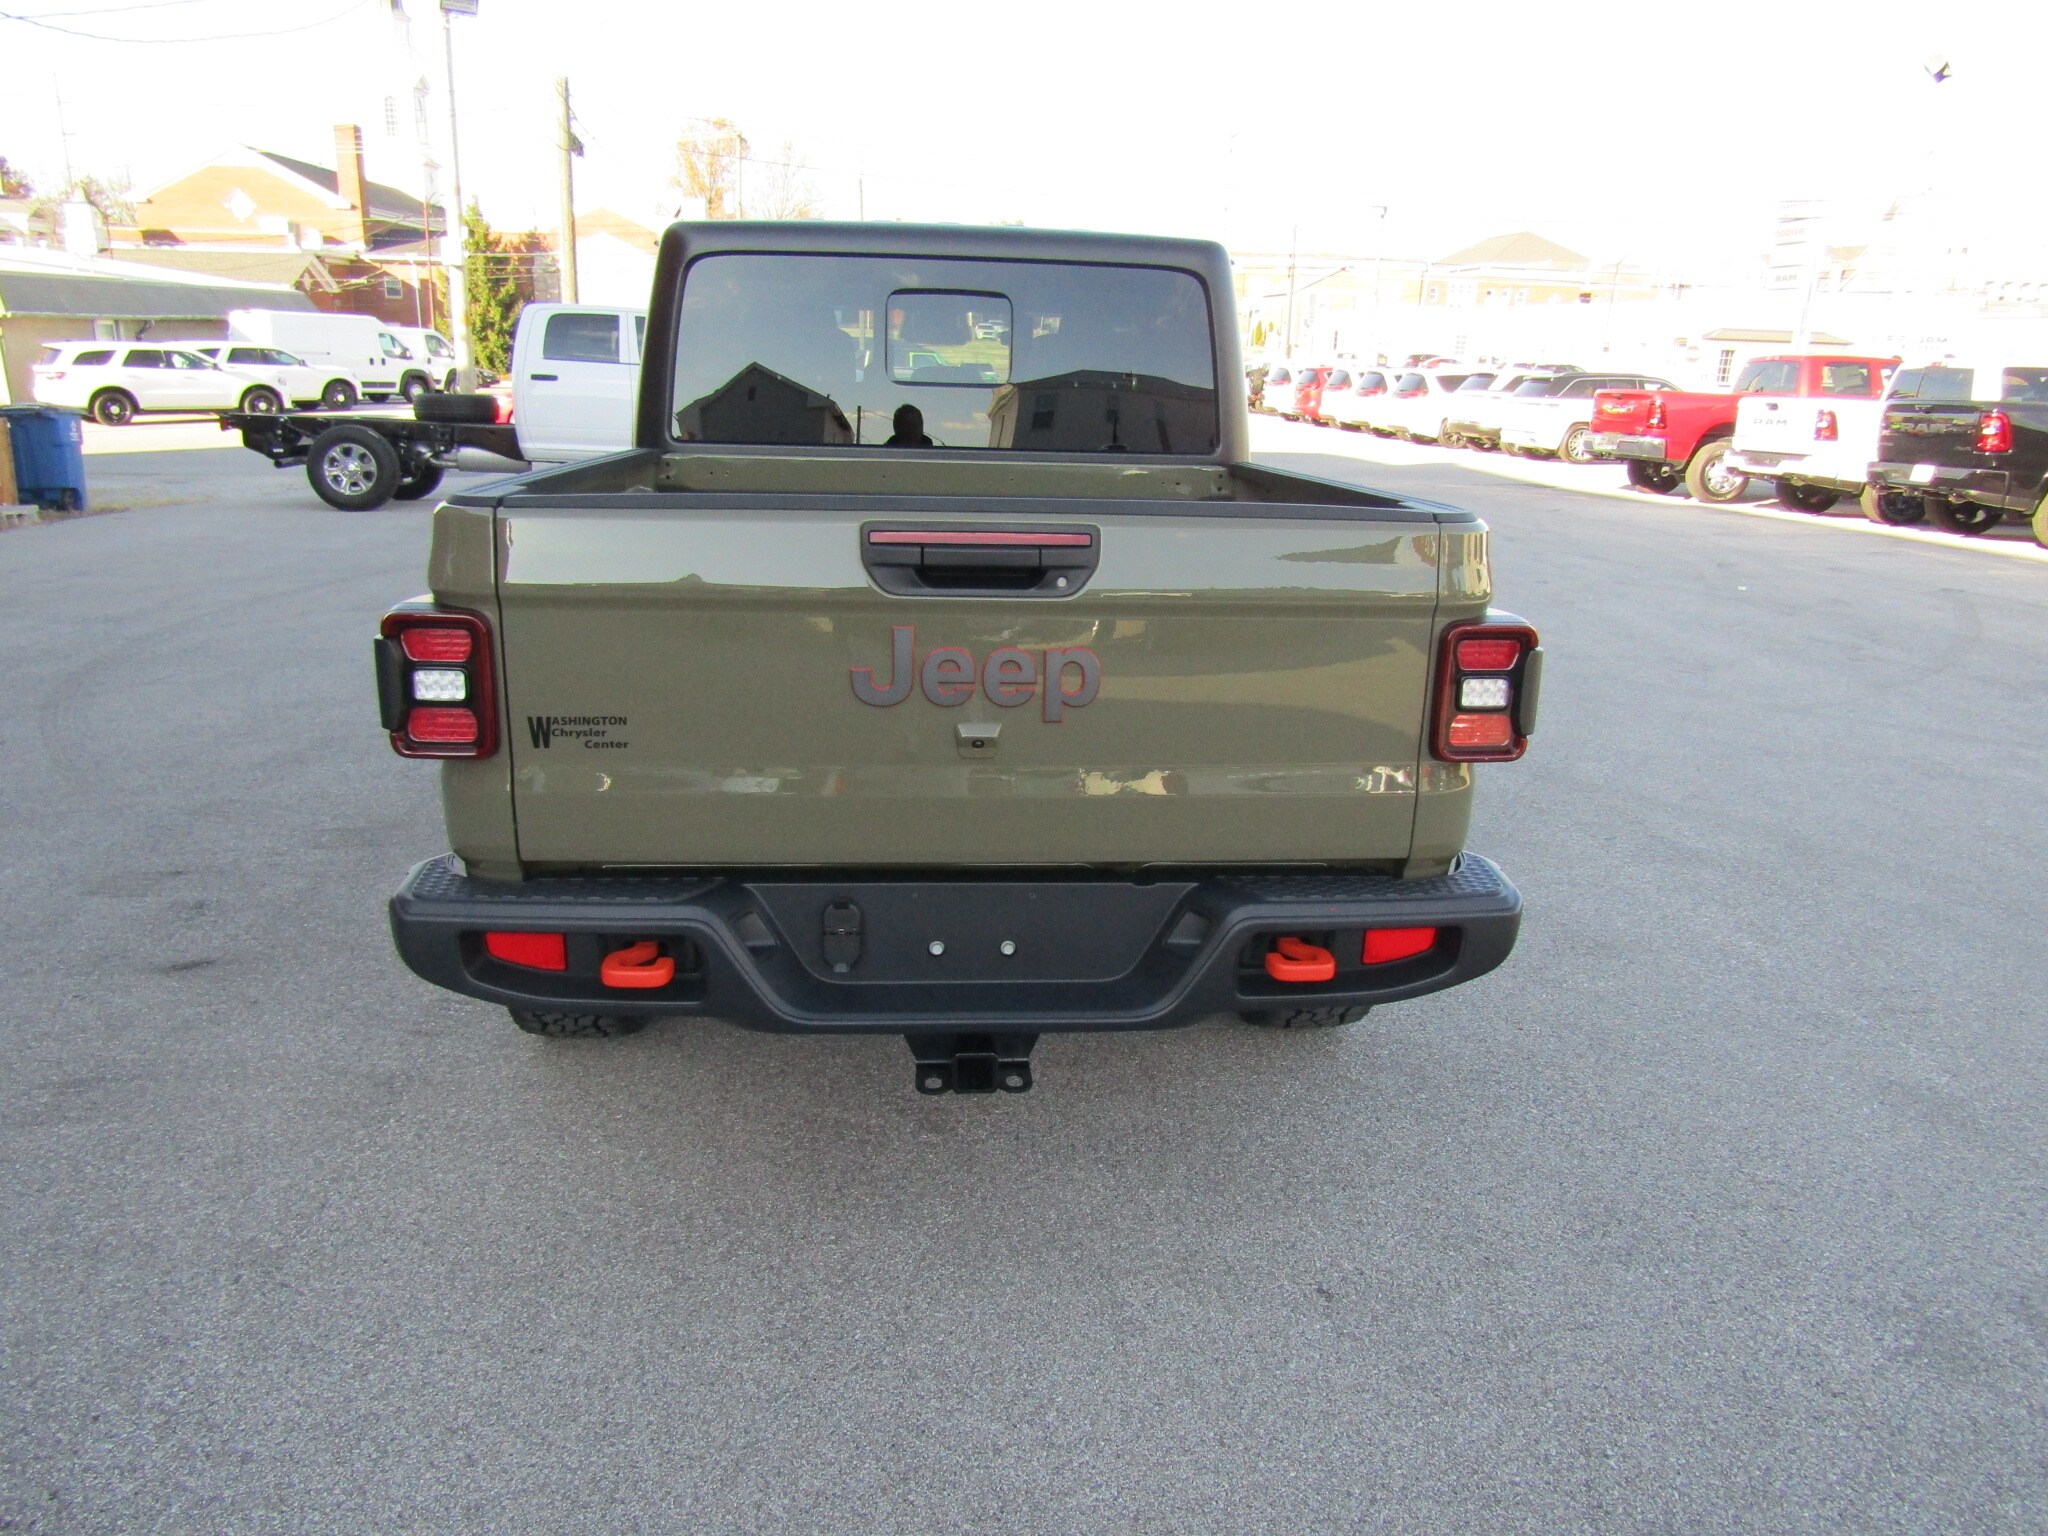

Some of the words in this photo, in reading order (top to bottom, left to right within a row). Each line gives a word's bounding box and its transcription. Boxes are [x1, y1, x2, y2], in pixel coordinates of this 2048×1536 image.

[1774, 273, 1798, 282] RAM
[1753, 418, 1788, 426] RAM
[850, 625, 1101, 723] Jeep
[527, 716, 628, 748] WASHINGTON
[551, 727, 607, 739] Chrysler
[584, 740, 629, 749] Center
